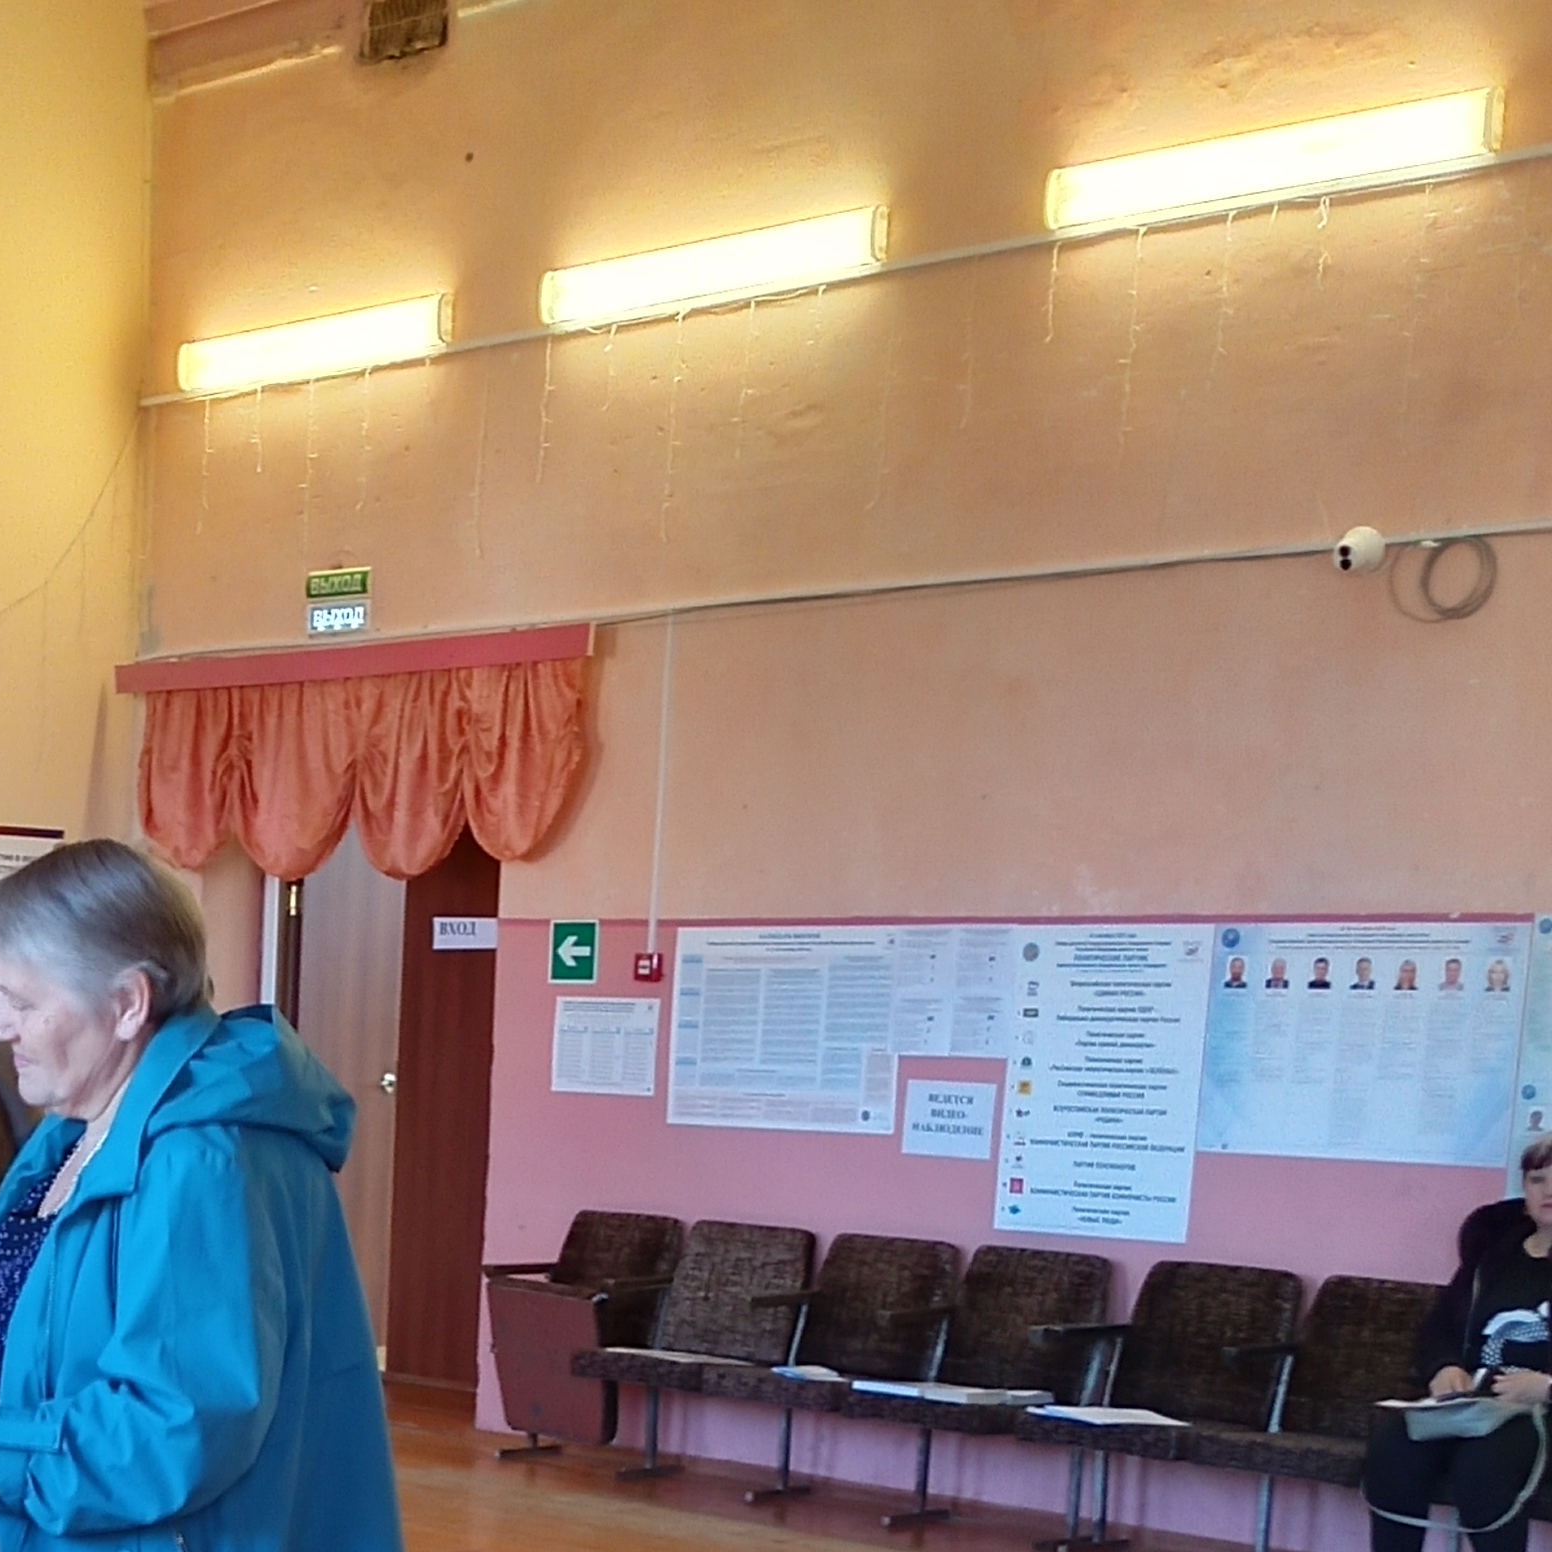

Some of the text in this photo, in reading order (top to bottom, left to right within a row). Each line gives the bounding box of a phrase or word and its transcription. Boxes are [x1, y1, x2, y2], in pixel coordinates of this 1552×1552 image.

[310, 573, 363, 595] ВЫХОД
[312, 606, 365, 628] ВЫХОД
[439, 921, 476, 936] ВХОД
[912, 1122, 984, 1136] НАБЛЮДЕНИЕ
